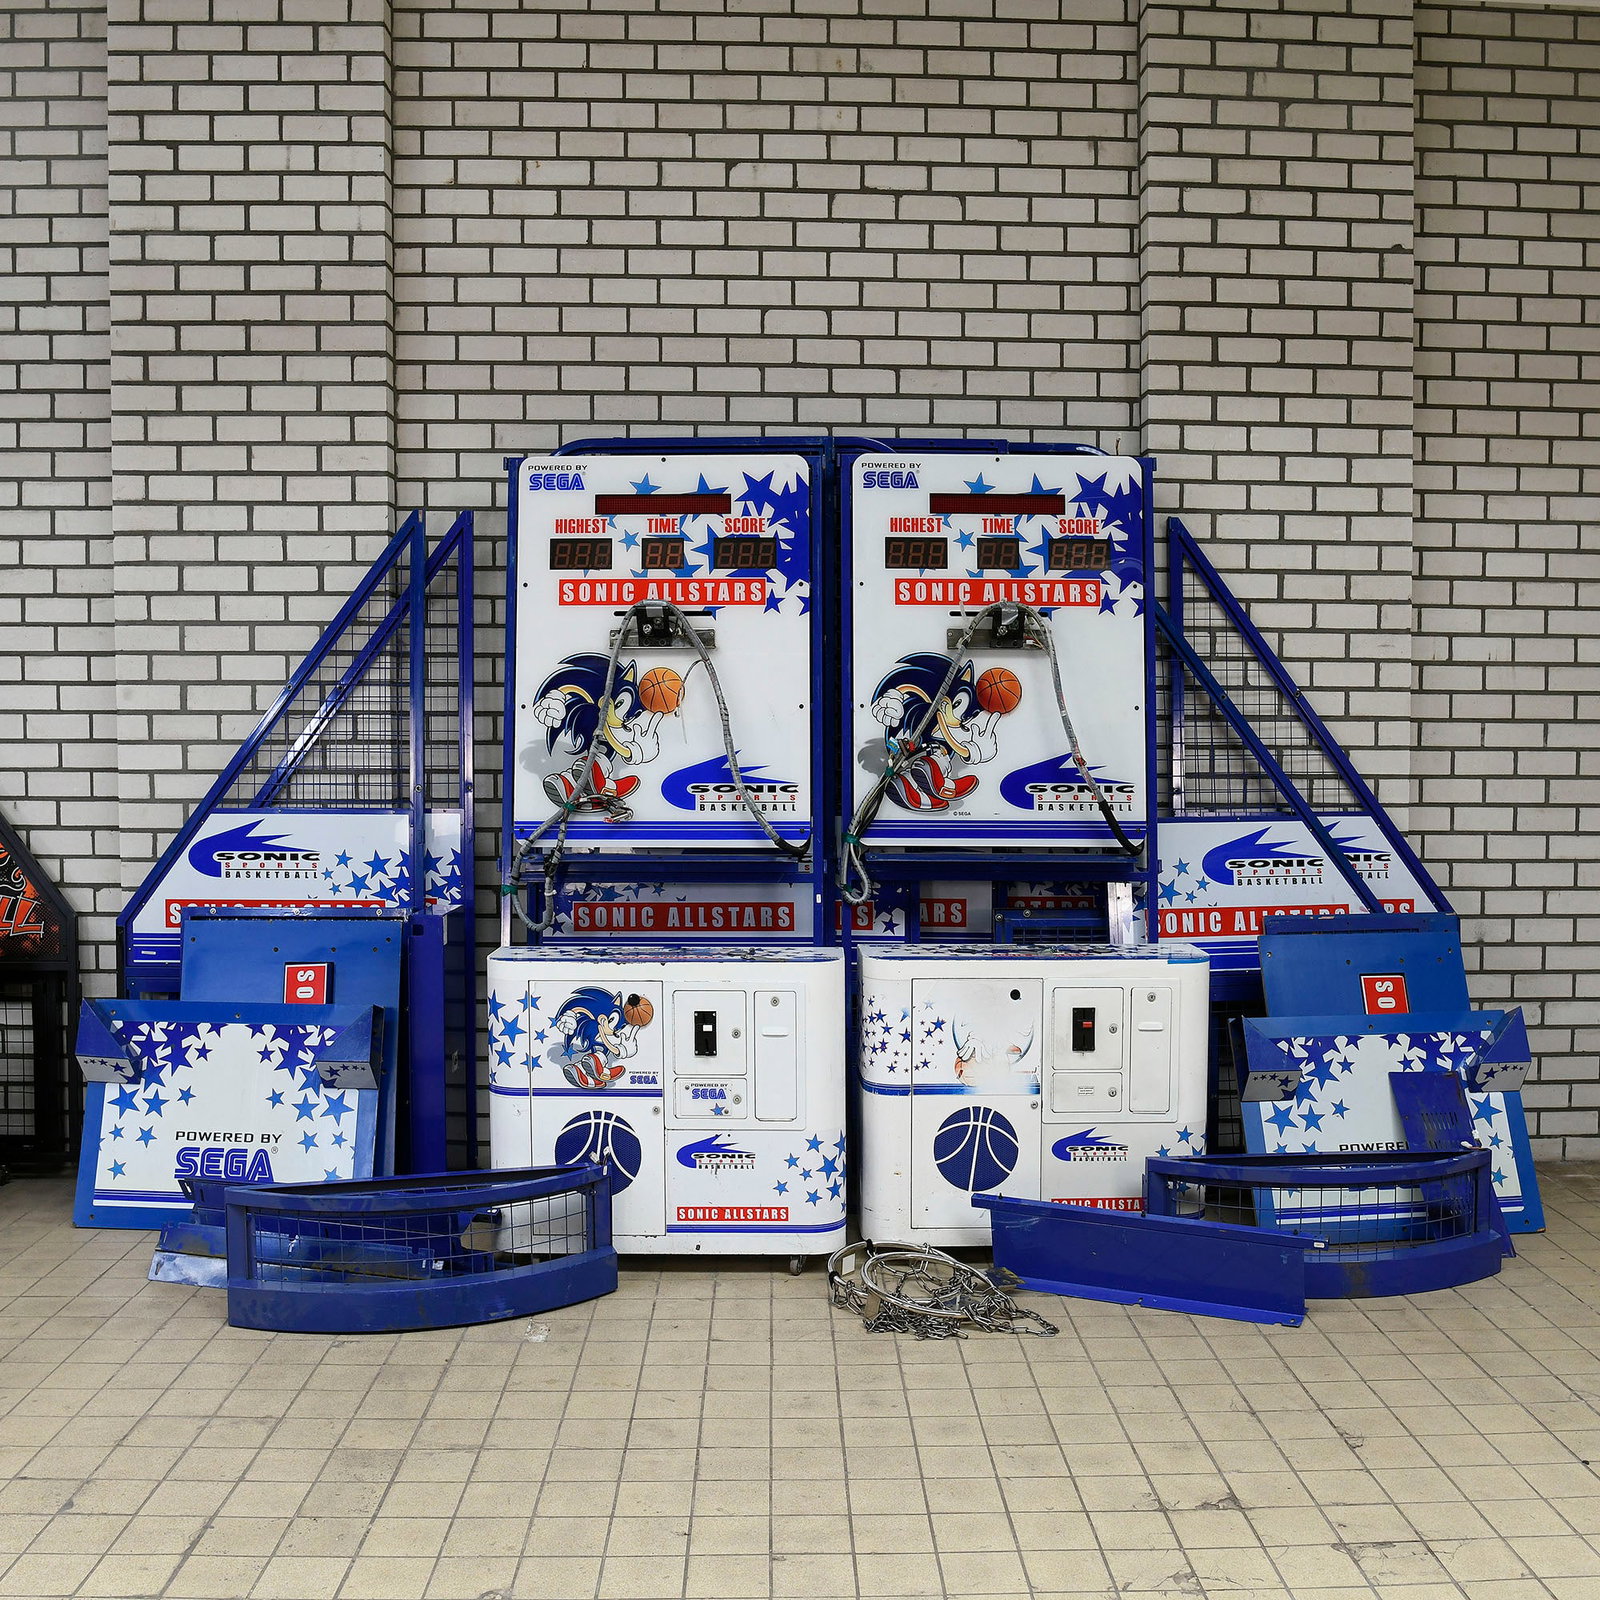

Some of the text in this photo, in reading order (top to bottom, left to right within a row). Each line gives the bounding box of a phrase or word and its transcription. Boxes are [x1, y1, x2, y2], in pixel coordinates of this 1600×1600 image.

[529, 473, 585, 491] SEGA
[863, 471, 920, 489] SEGA
[555, 518, 766, 534] HIGHEST TIME SCORE
[890, 517, 1100, 534] HIGHEST TIME SCORE
[562, 582, 763, 602] SONIC ALLSTARS
[899, 582, 1097, 603] SONIC ALLSTARS
[691, 785, 799, 793] SONIC
[1029, 784, 1135, 793] SONIC
[216, 852, 320, 861] SONIC
[1228, 859, 1324, 869] SONIC
[225, 871, 317, 879] BASKETBALL
[1237, 877, 1323, 886] BASKETBALL
[577, 906, 791, 928] SONIC ALLSTARS
[629, 1075, 658, 1084] SEGA
[692, 1088, 727, 1099] SEGA
[176, 1131, 283, 1144] POWERED BY
[174, 1146, 275, 1183] SEGA
[679, 1208, 787, 1220] SONIC ALLSTARS
